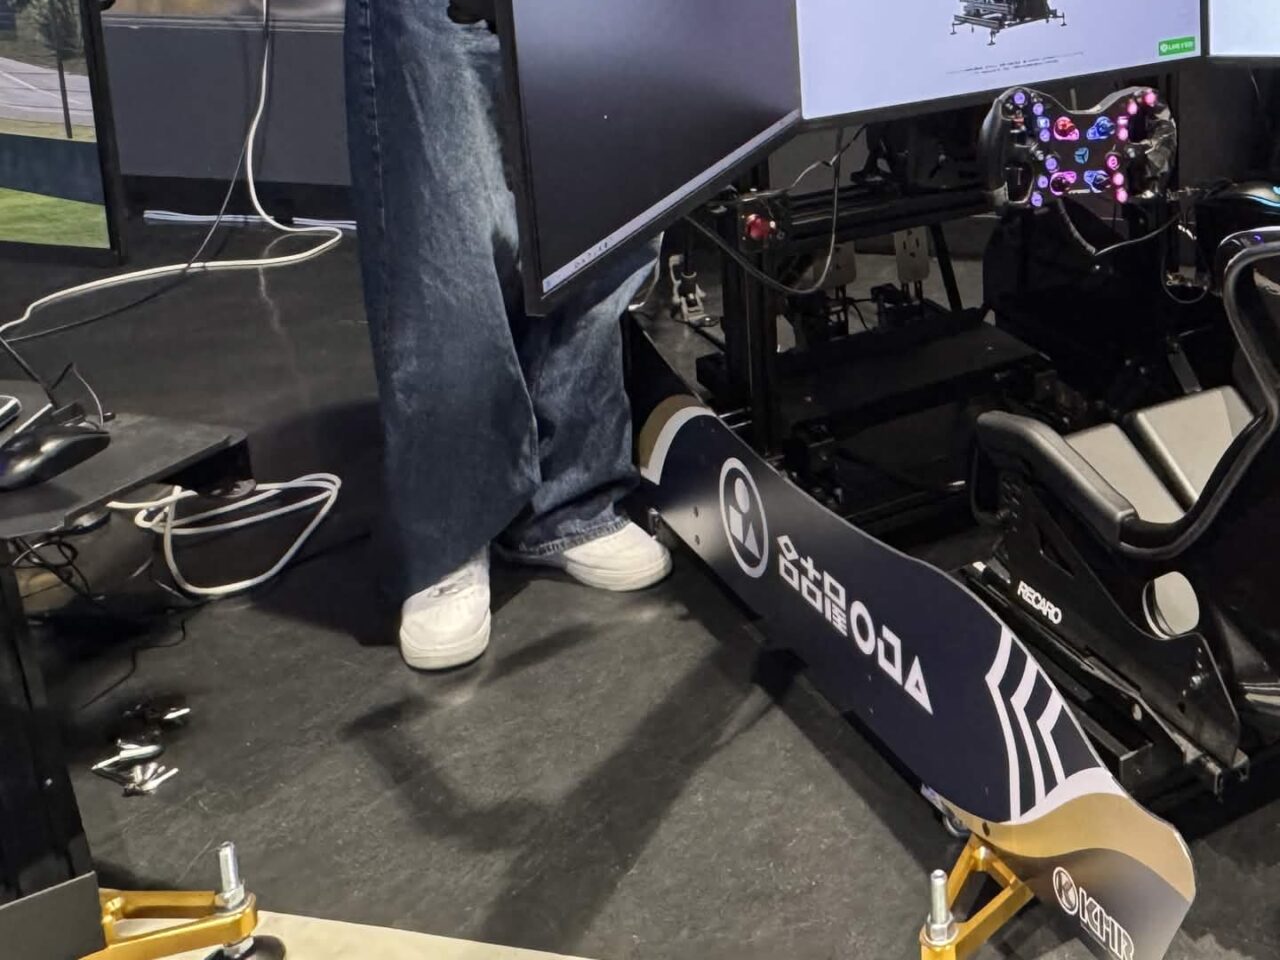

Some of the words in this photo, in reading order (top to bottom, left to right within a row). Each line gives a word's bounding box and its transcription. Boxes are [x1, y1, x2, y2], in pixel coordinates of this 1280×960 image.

[777, 534, 934, 716] 名古屋OJA
[1017, 580, 1062, 624] RECARO
